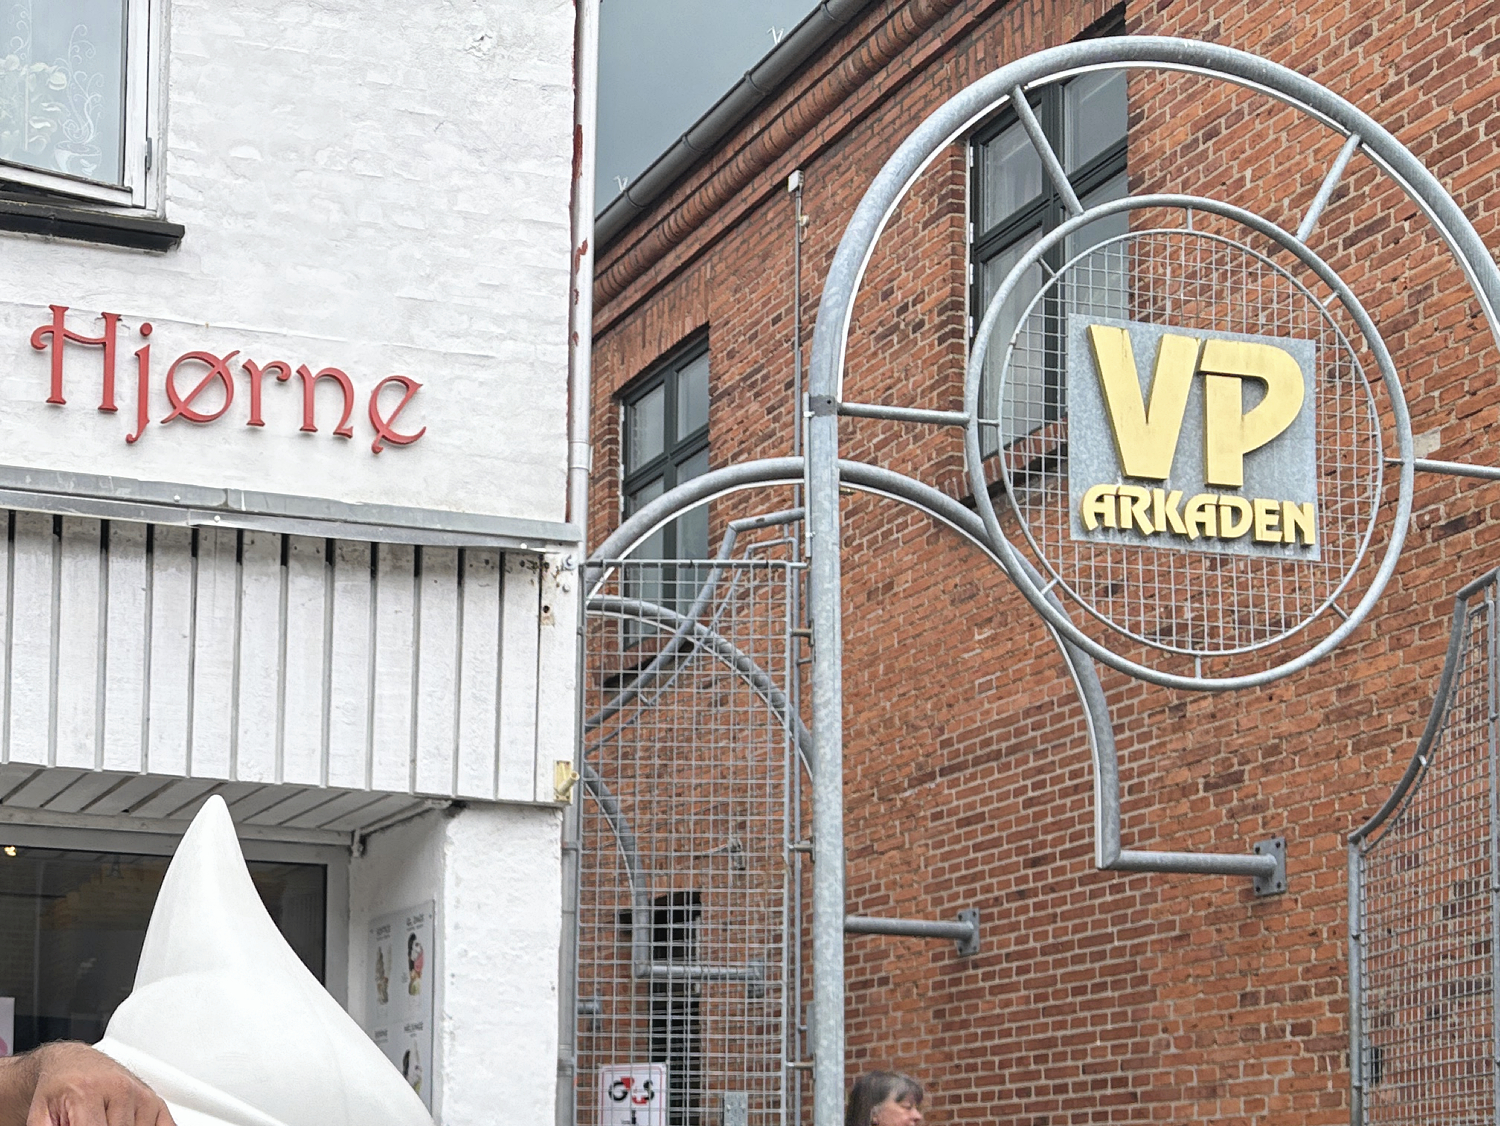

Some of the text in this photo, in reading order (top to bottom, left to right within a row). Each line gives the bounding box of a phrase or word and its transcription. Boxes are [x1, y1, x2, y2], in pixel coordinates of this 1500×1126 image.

[30, 304, 428, 453] Hjørne
[1087, 323, 1306, 488] VP
[1079, 483, 1317, 547] ARKADEN
